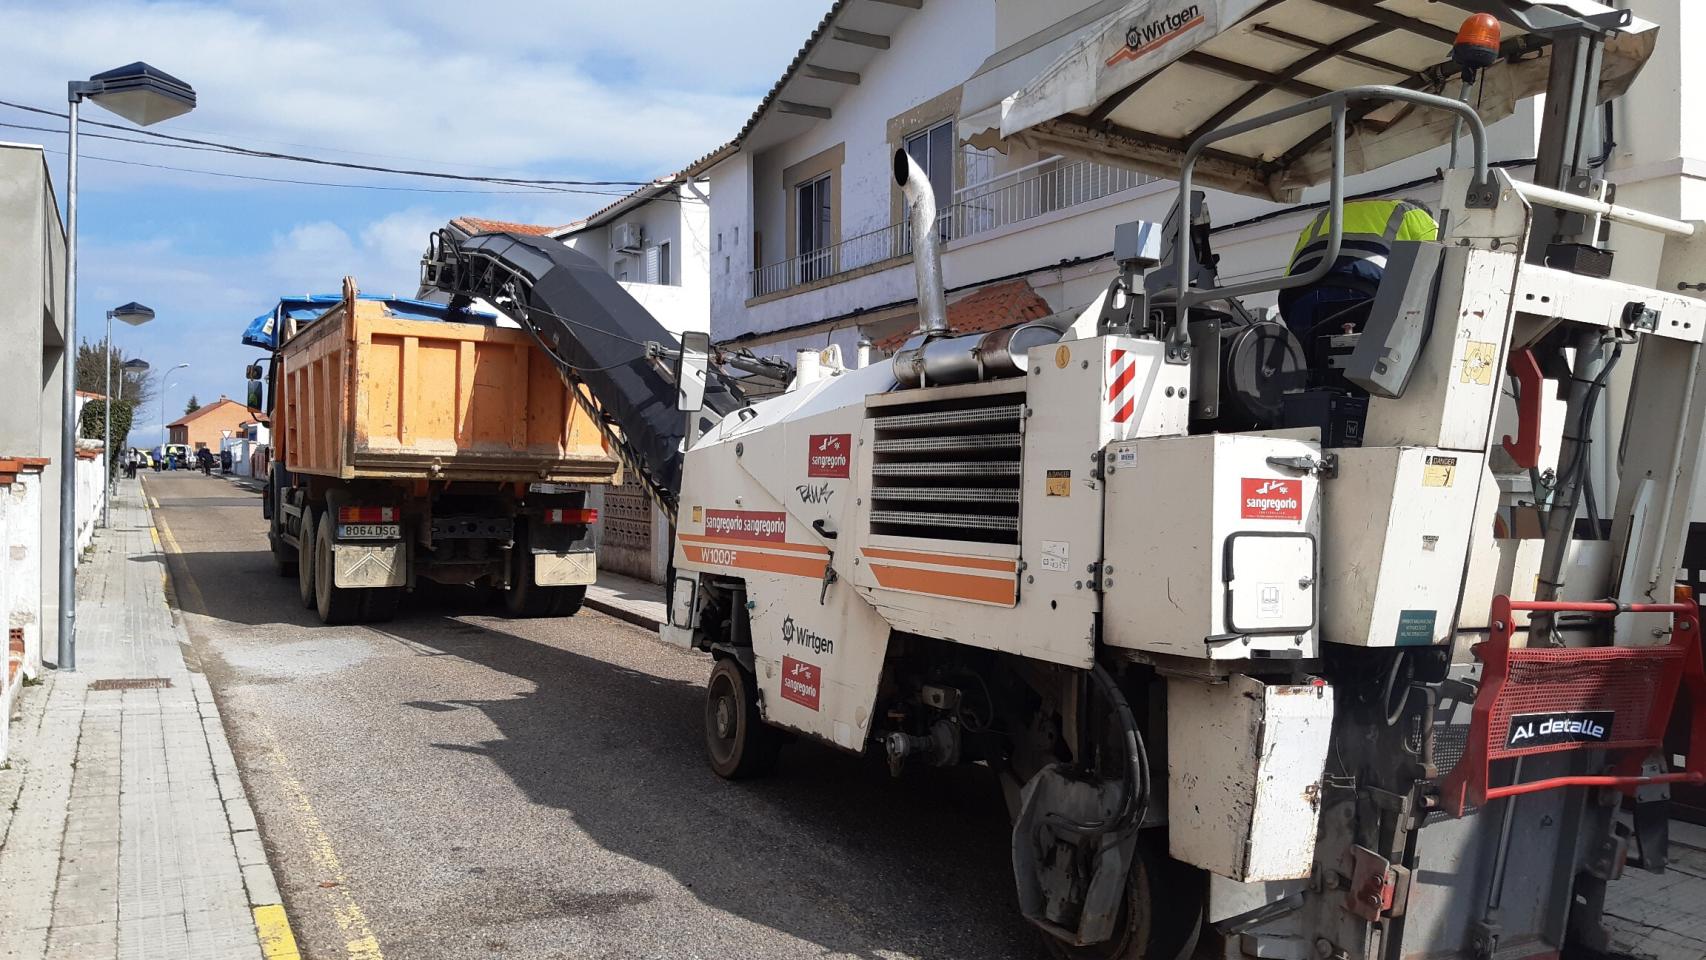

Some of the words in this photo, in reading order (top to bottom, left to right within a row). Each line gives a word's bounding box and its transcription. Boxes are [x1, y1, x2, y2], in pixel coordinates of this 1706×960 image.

[1142, 4, 1199, 42] Wirtgen
[812, 454, 846, 468] sangregorio
[1433, 457, 1456, 466] DANGER
[1246, 498, 1297, 511] sangregorio
[346, 526, 372, 536] 8064
[375, 526, 396, 536] DSG
[706, 516, 743, 533] sangregorio
[743, 517, 785, 536] sangregorio
[701, 547, 737, 565] W1000F
[797, 626, 834, 655] Wirtgen
[784, 677, 817, 697] sangregorio
[1511, 722, 1535, 744] Al
[1539, 718, 1604, 738] detalle
